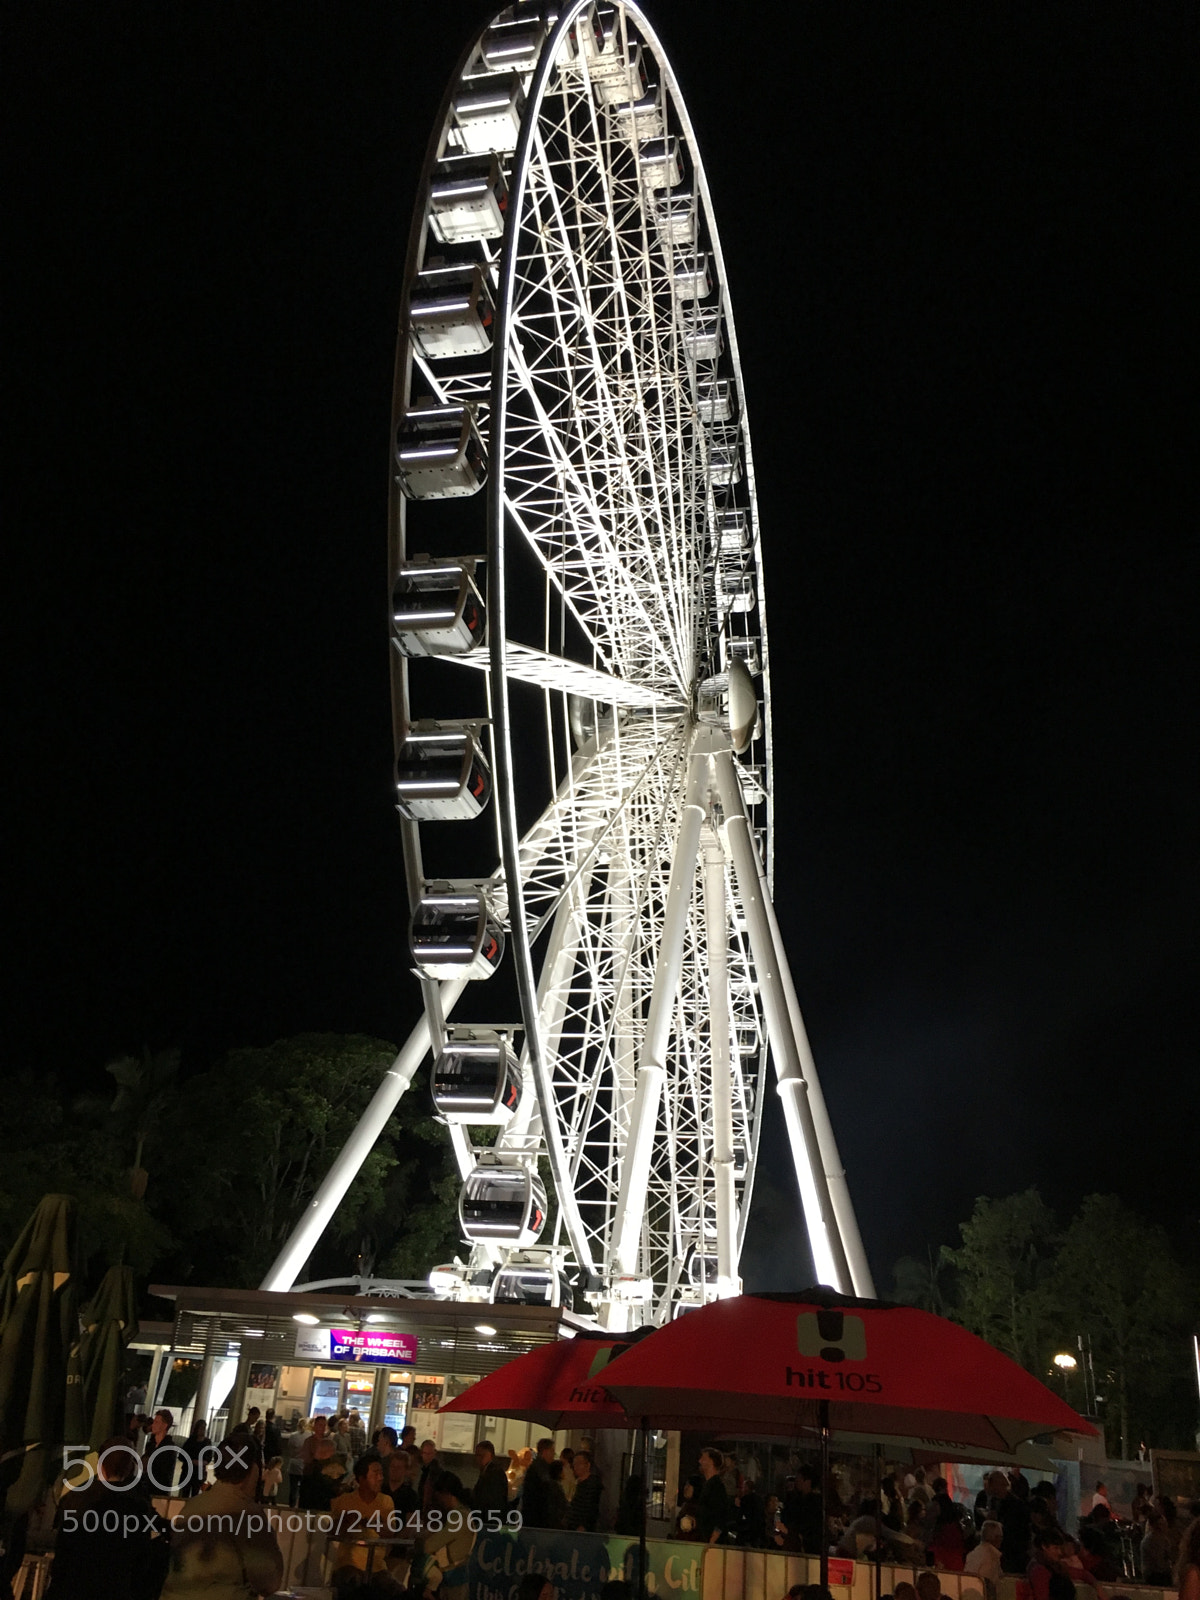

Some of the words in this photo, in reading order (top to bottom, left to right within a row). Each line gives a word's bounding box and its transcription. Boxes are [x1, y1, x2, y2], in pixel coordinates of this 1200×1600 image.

[341, 1336, 365, 1346] THE
[367, 1338, 407, 1349] WHEEL
[333, 1345, 350, 1354] OF
[352, 1347, 413, 1359] BRISBANE
